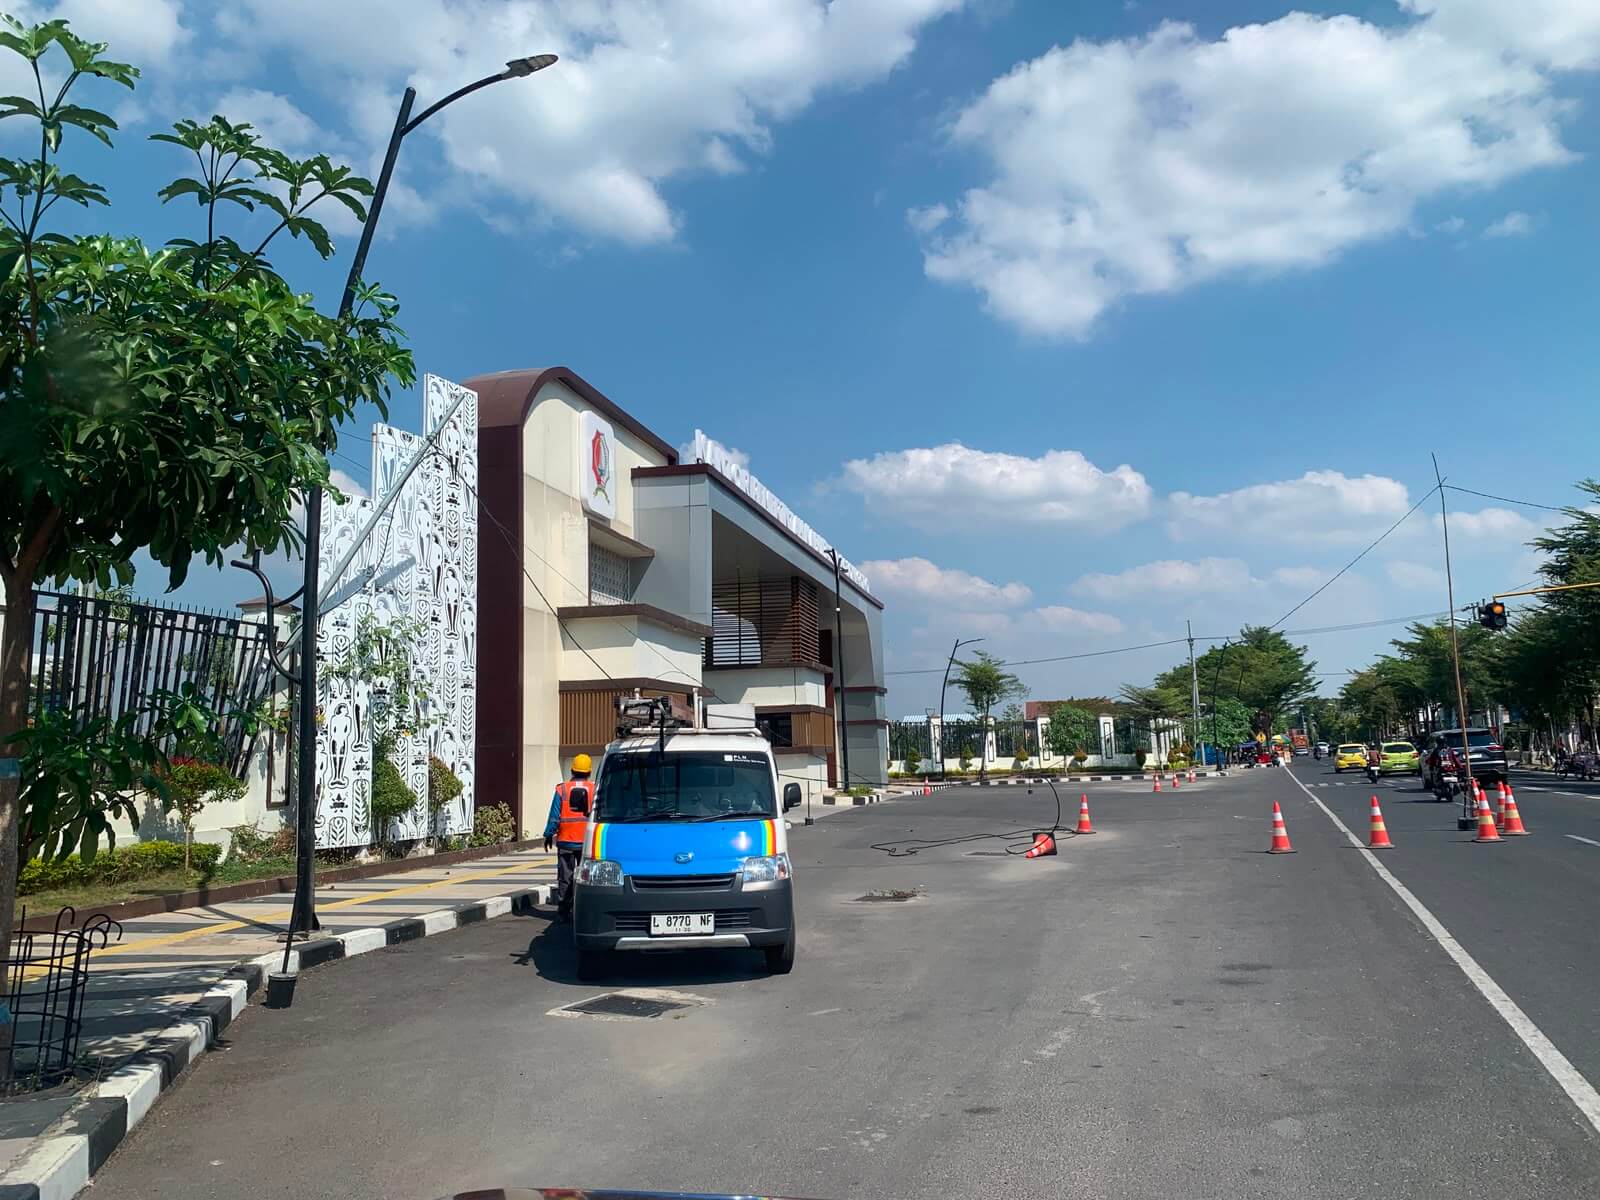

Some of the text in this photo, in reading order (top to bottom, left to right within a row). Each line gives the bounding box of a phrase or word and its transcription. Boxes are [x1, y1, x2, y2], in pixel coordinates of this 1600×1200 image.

[653, 914, 712, 927] L 8770 NF
